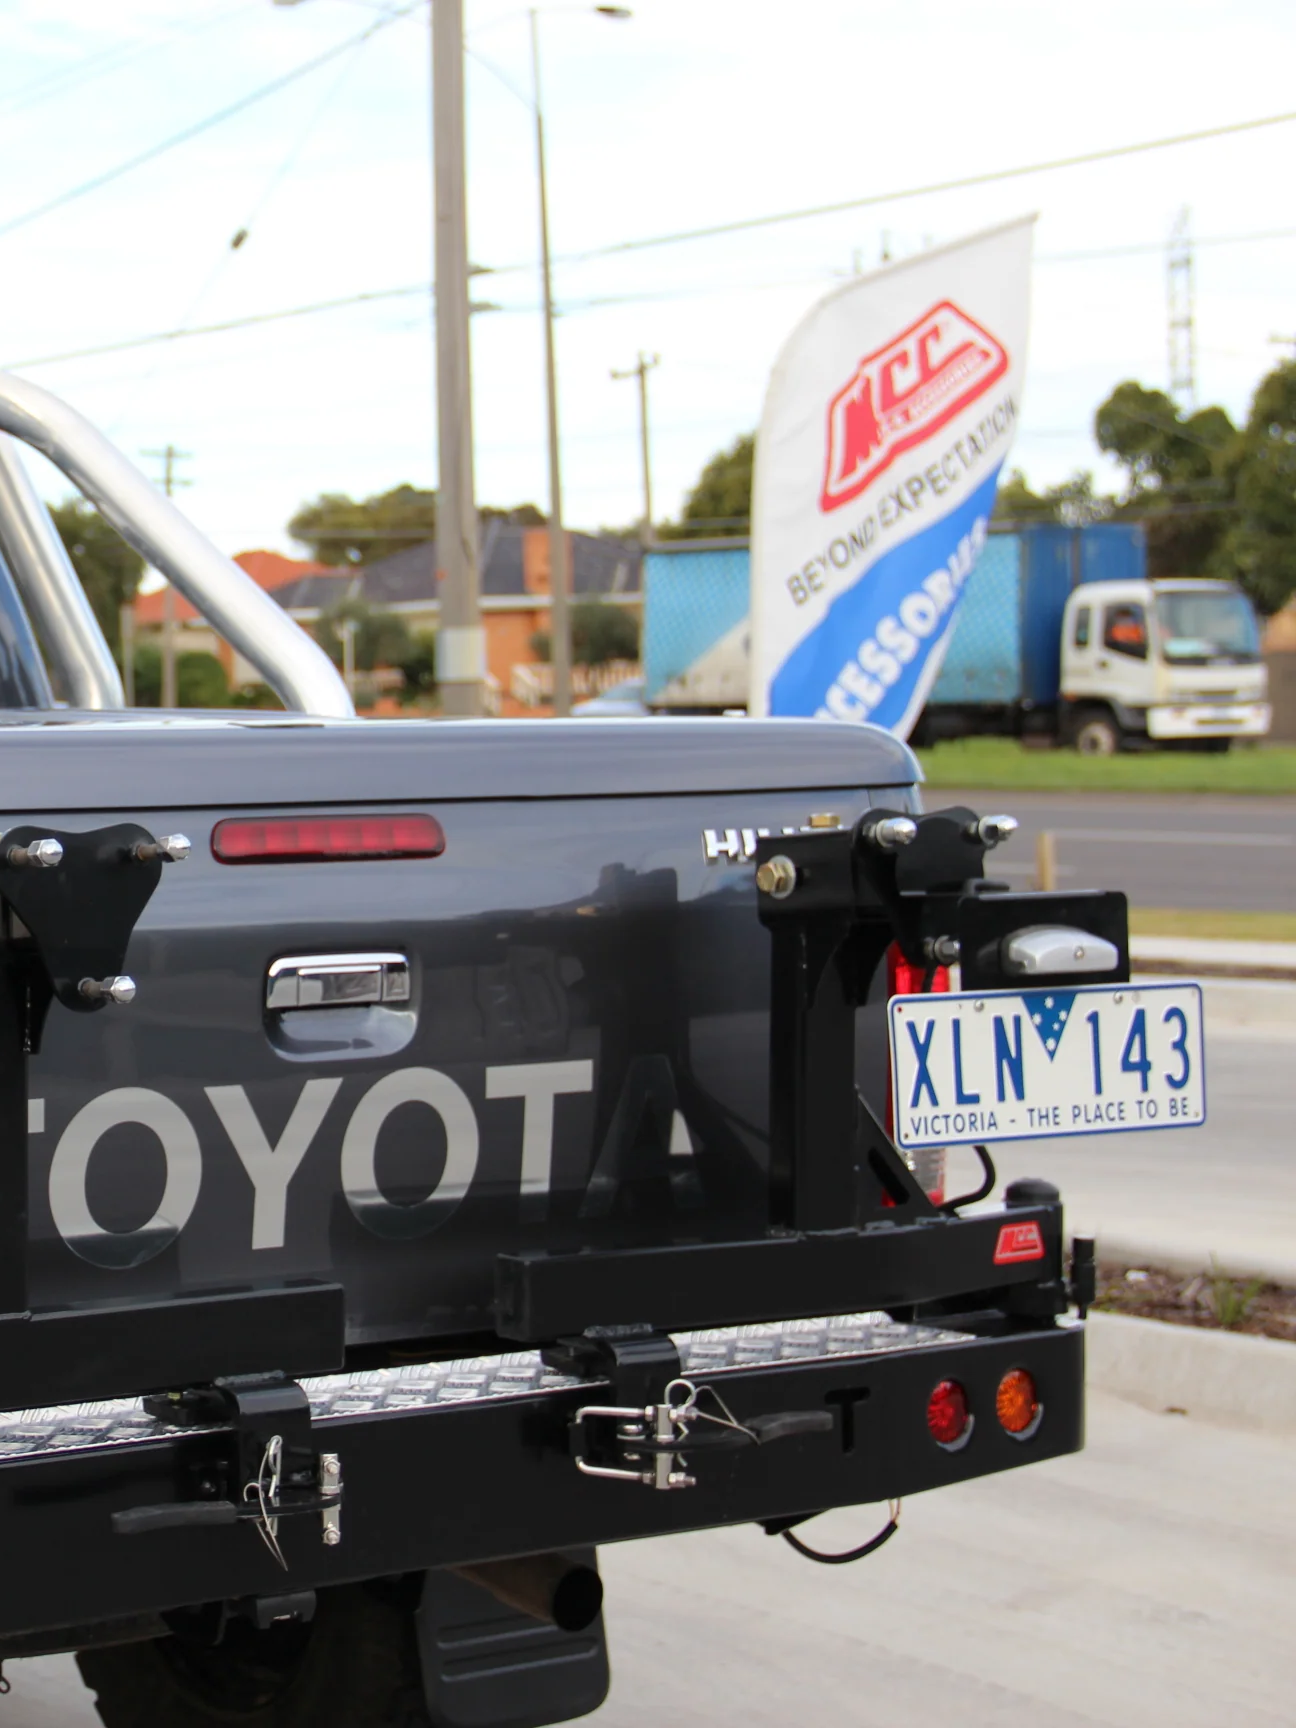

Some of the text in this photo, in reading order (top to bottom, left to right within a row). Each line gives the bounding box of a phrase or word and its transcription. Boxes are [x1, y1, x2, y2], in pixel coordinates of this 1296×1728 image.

[786, 515, 875, 606] BEYOND
[905, 1006, 1190, 1108] XLN 143
[910, 1111, 998, 1137] VICTORIA
[1027, 1106, 1060, 1128] THE
[1072, 1101, 1126, 1124] PLACE
[1137, 1099, 1158, 1120] TO
[1169, 1097, 1189, 1117] BE
